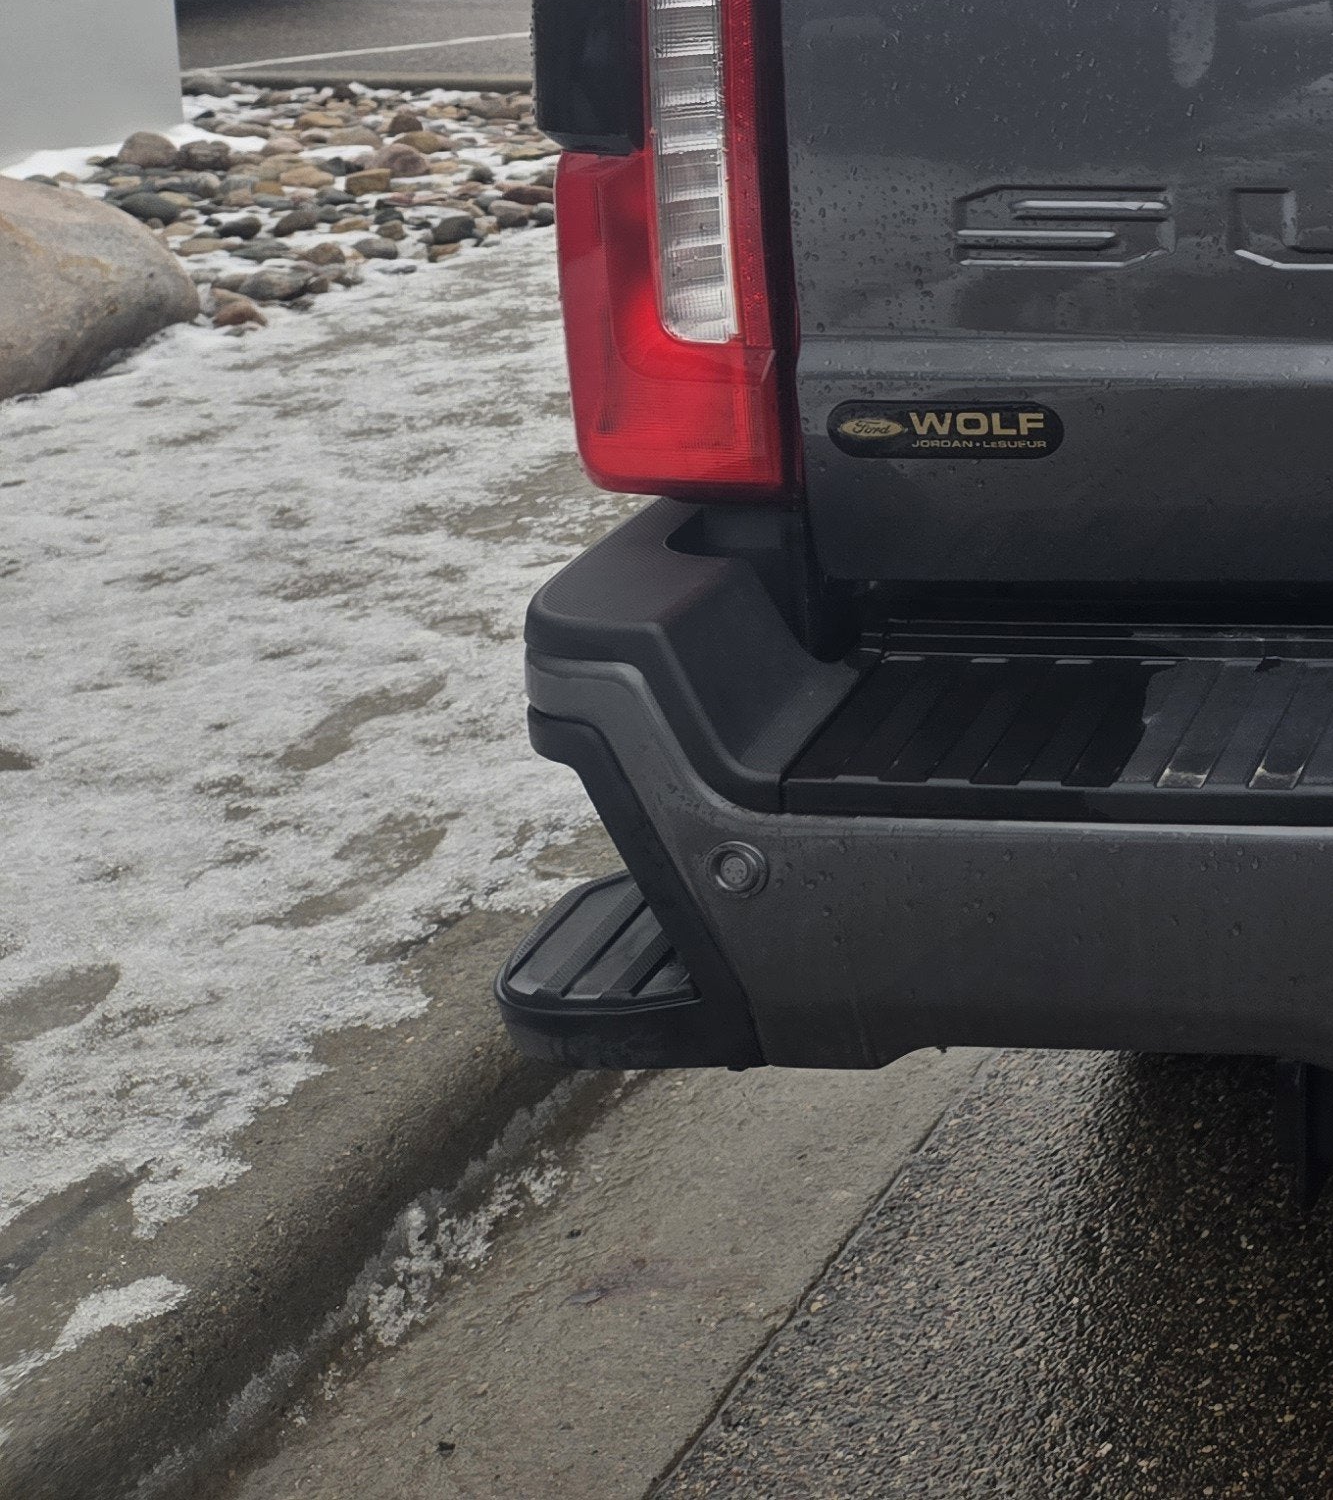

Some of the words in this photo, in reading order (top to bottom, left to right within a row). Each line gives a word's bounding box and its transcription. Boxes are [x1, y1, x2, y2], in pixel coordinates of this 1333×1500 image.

[851, 419, 892, 436] Ford
[909, 412, 1045, 435] WOLF
[911, 439, 973, 448] JORDAN
